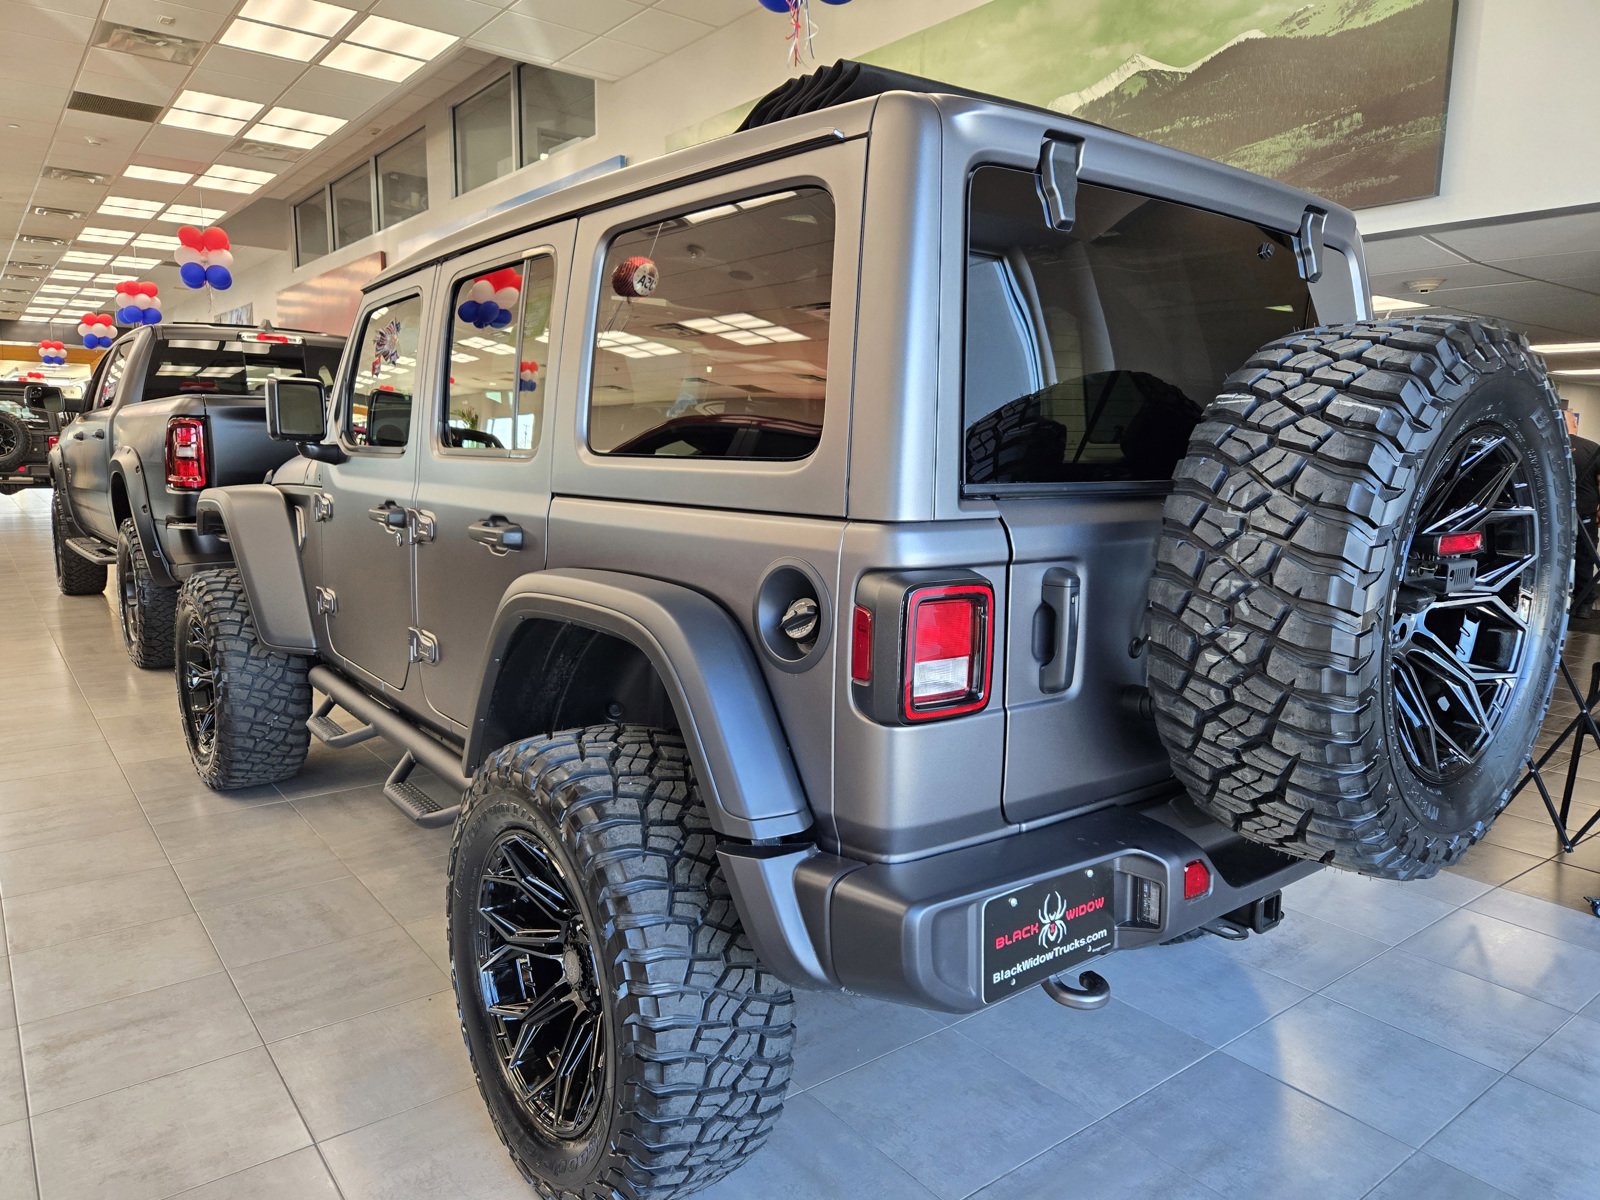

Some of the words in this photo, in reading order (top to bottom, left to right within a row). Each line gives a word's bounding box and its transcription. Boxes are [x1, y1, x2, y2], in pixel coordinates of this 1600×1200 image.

[995, 922, 1039, 949] BLACK
[1065, 897, 1105, 920] WIDOW
[992, 929, 1108, 984] BlackWidowTrucks.com
